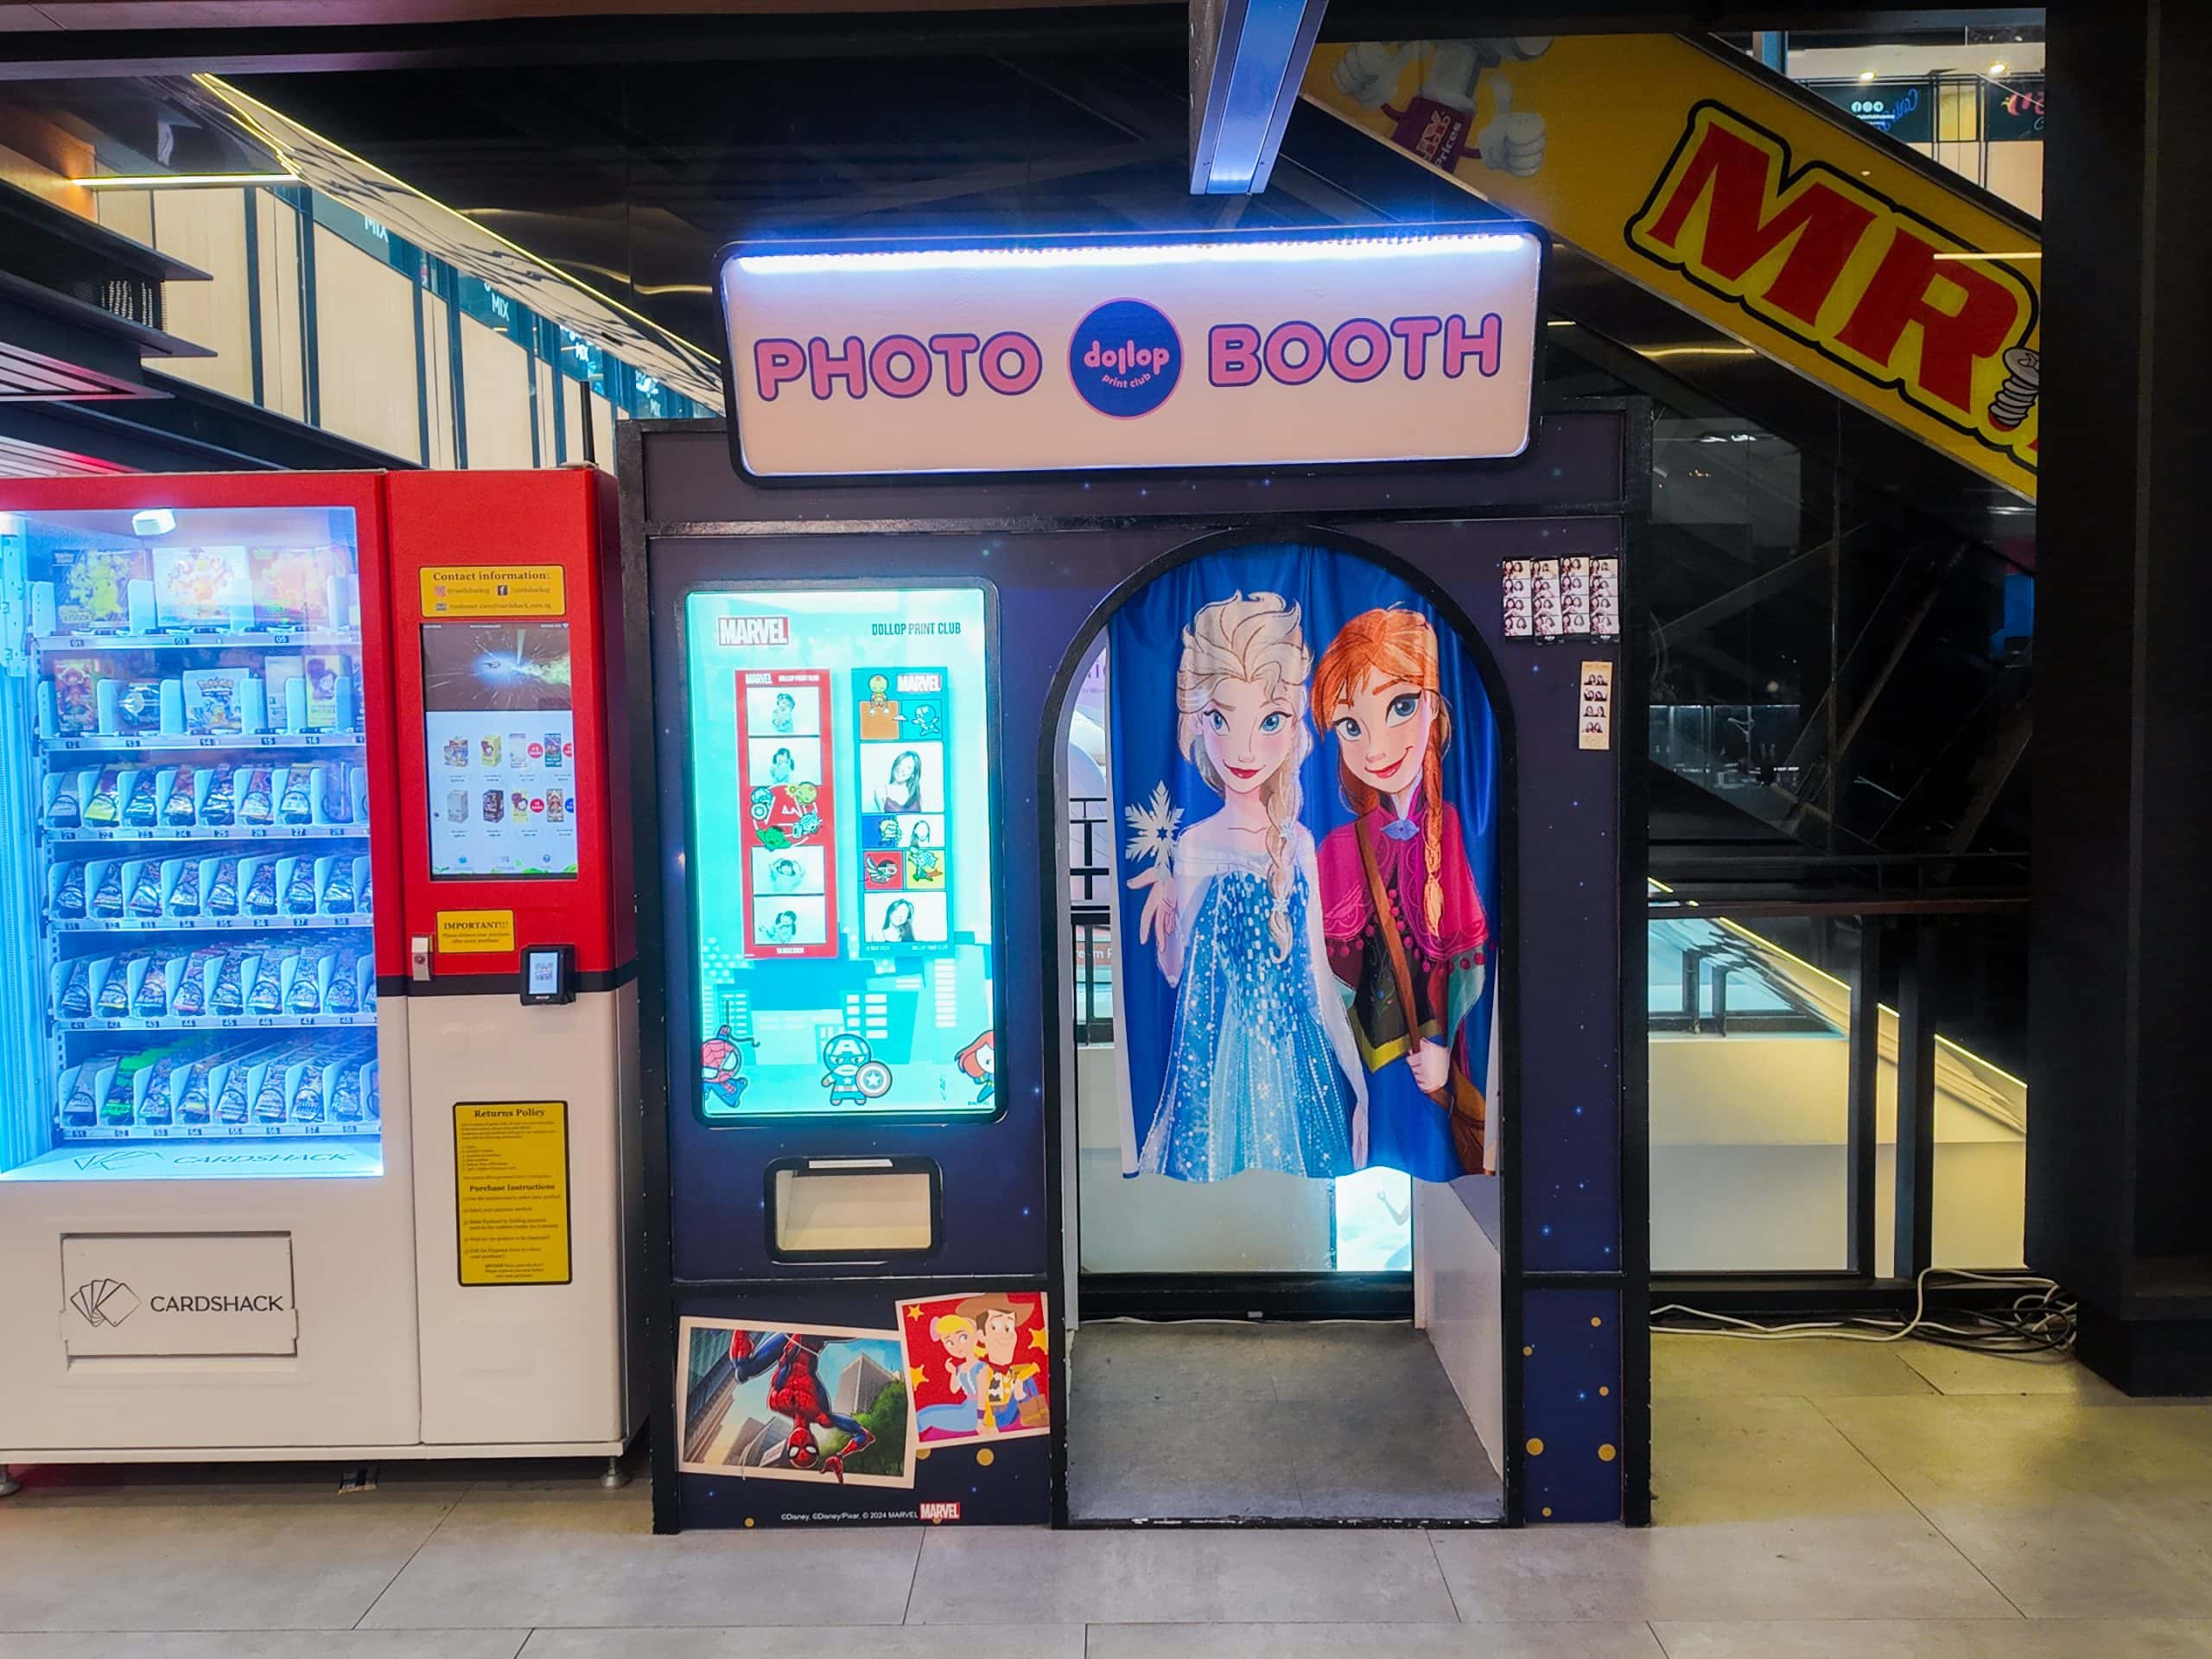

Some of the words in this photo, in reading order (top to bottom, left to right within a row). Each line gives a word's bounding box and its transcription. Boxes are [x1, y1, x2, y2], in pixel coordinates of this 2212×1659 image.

[491, 292, 510, 321] MIX
[753, 331, 1043, 402] PHOTO
[1209, 313, 1503, 388] BOOTH
[1084, 340, 1170, 375] dollop
[1101, 374, 1128, 388] print
[1129, 372, 1152, 388] club
[434, 572, 475, 582] Contact
[479, 570, 550, 581] information:
[719, 617, 788, 645] MARVEL
[872, 622, 906, 636] DOLLOP
[908, 622, 936, 635] PRINT
[938, 622, 962, 634] CLUB
[897, 674, 941, 692] MARVEL
[474, 1109, 513, 1118] Returns
[516, 1108, 544, 1119] Policy
[173, 1153, 354, 1165] CARDSHACK
[507, 1182, 556, 1192] Instructions
[150, 1295, 284, 1313] CARDSHACK
[919, 1502, 960, 1520] MARVEL
